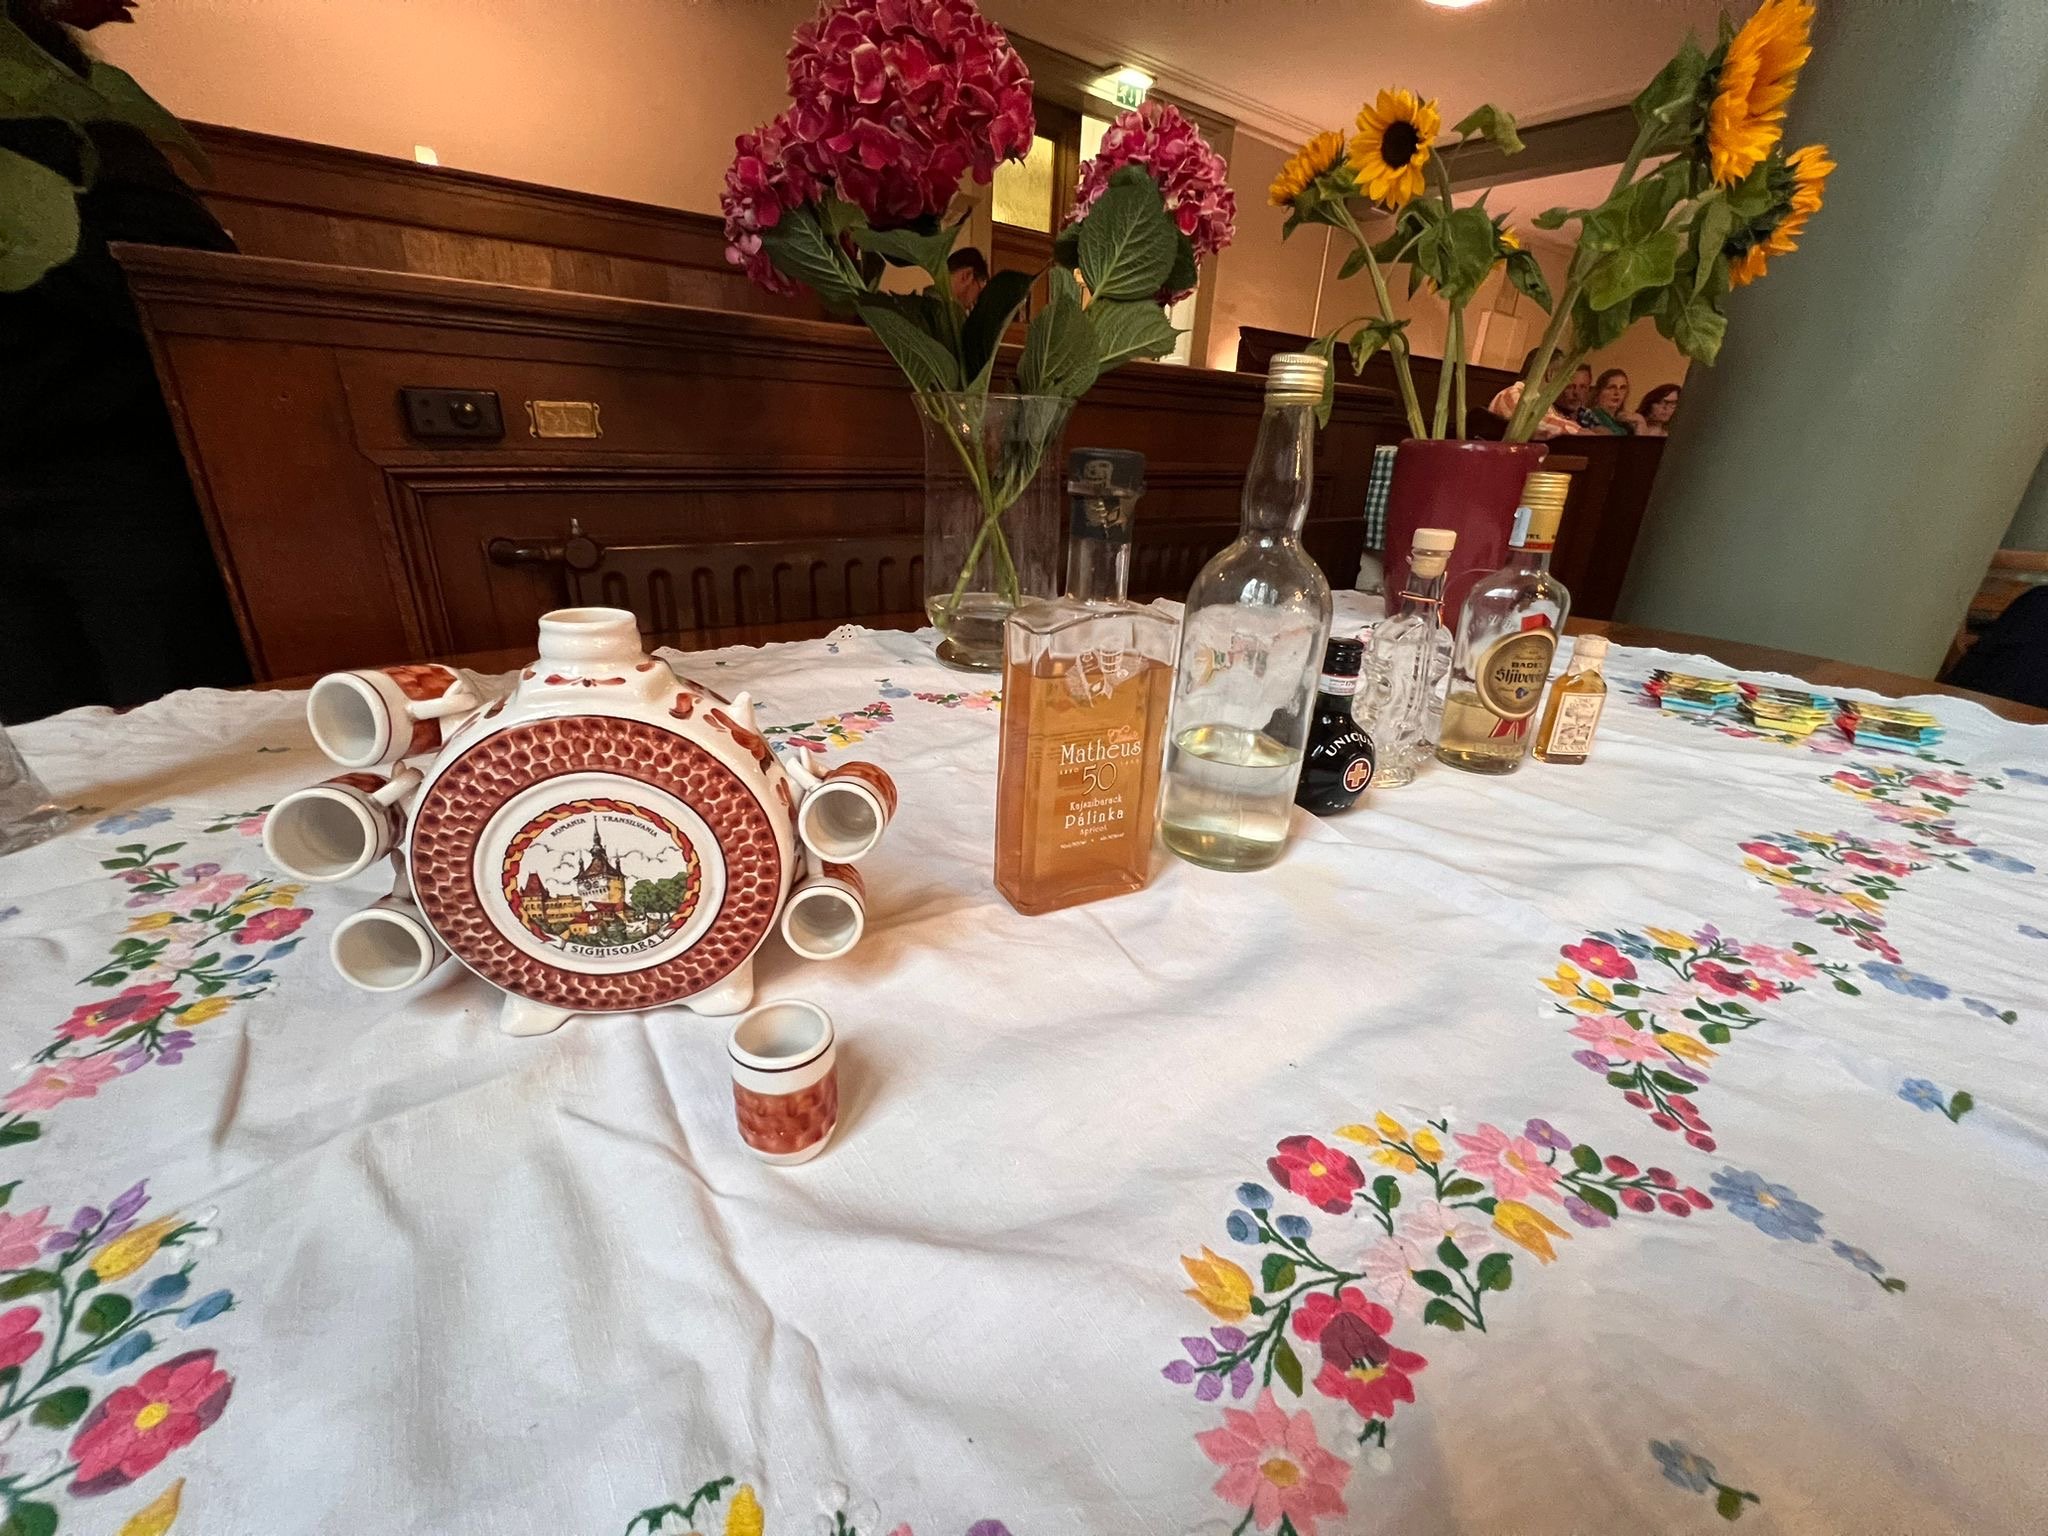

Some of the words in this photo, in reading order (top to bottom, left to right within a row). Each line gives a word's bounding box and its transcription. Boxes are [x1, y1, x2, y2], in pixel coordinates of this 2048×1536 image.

[1060, 740, 1141, 766] Matheus
[1082, 762, 1117, 795] 50
[550, 818, 586, 837] ROMANIA
[602, 815, 658, 838] TRANSILVANIA
[1064, 807, 1124, 829] Pálinka
